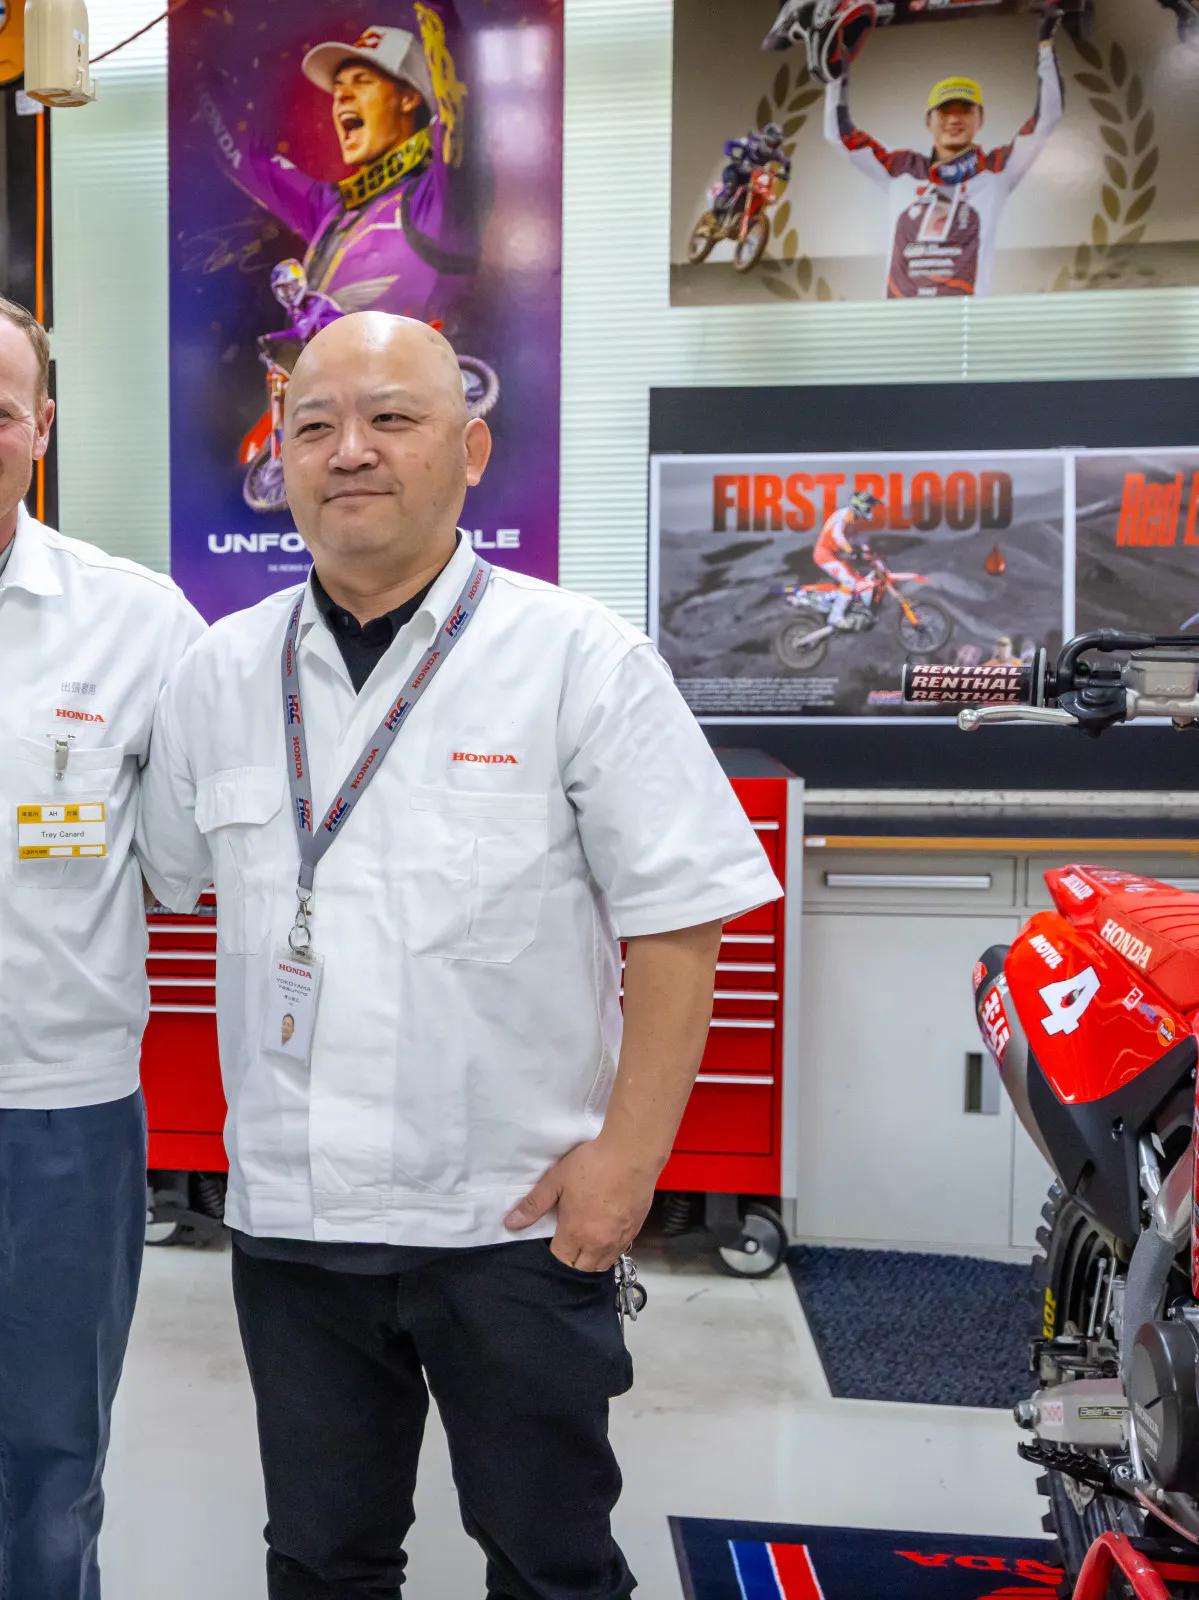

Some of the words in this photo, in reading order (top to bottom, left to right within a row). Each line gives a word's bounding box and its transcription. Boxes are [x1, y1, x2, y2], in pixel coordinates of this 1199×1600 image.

[713, 472, 850, 533] FIRST
[855, 471, 1013, 531] BLOOD
[1116, 472, 1185, 547] Red
[467, 568, 484, 600] HONDA
[445, 605, 468, 638] HRC
[411, 650, 441, 690] HONDA
[911, 676, 1021, 690] RENTHAL
[912, 664, 1023, 676] RENTHAL
[60, 681, 98, 696] 出張者用
[911, 690, 1022, 701] RENTHAL
[55, 708, 105, 723] HONDA
[288, 694, 301, 725] HRC
[384, 697, 409, 733] HRC
[292, 735, 303, 780] HONDA
[351, 747, 380, 790] HONDA
[451, 751, 520, 765] HONDA
[298, 797, 312, 833] HRC
[323, 797, 349, 833] HRC
[41, 831, 57, 839] Trey
[59, 830, 85, 838] Canard
[1028, 934, 1064, 970] MOTUL
[1100, 918, 1153, 969] HONDA
[276, 977, 312, 992] YOKOYAMA
[278, 963, 313, 980] HONDA
[1038, 965, 1102, 1037] 4
